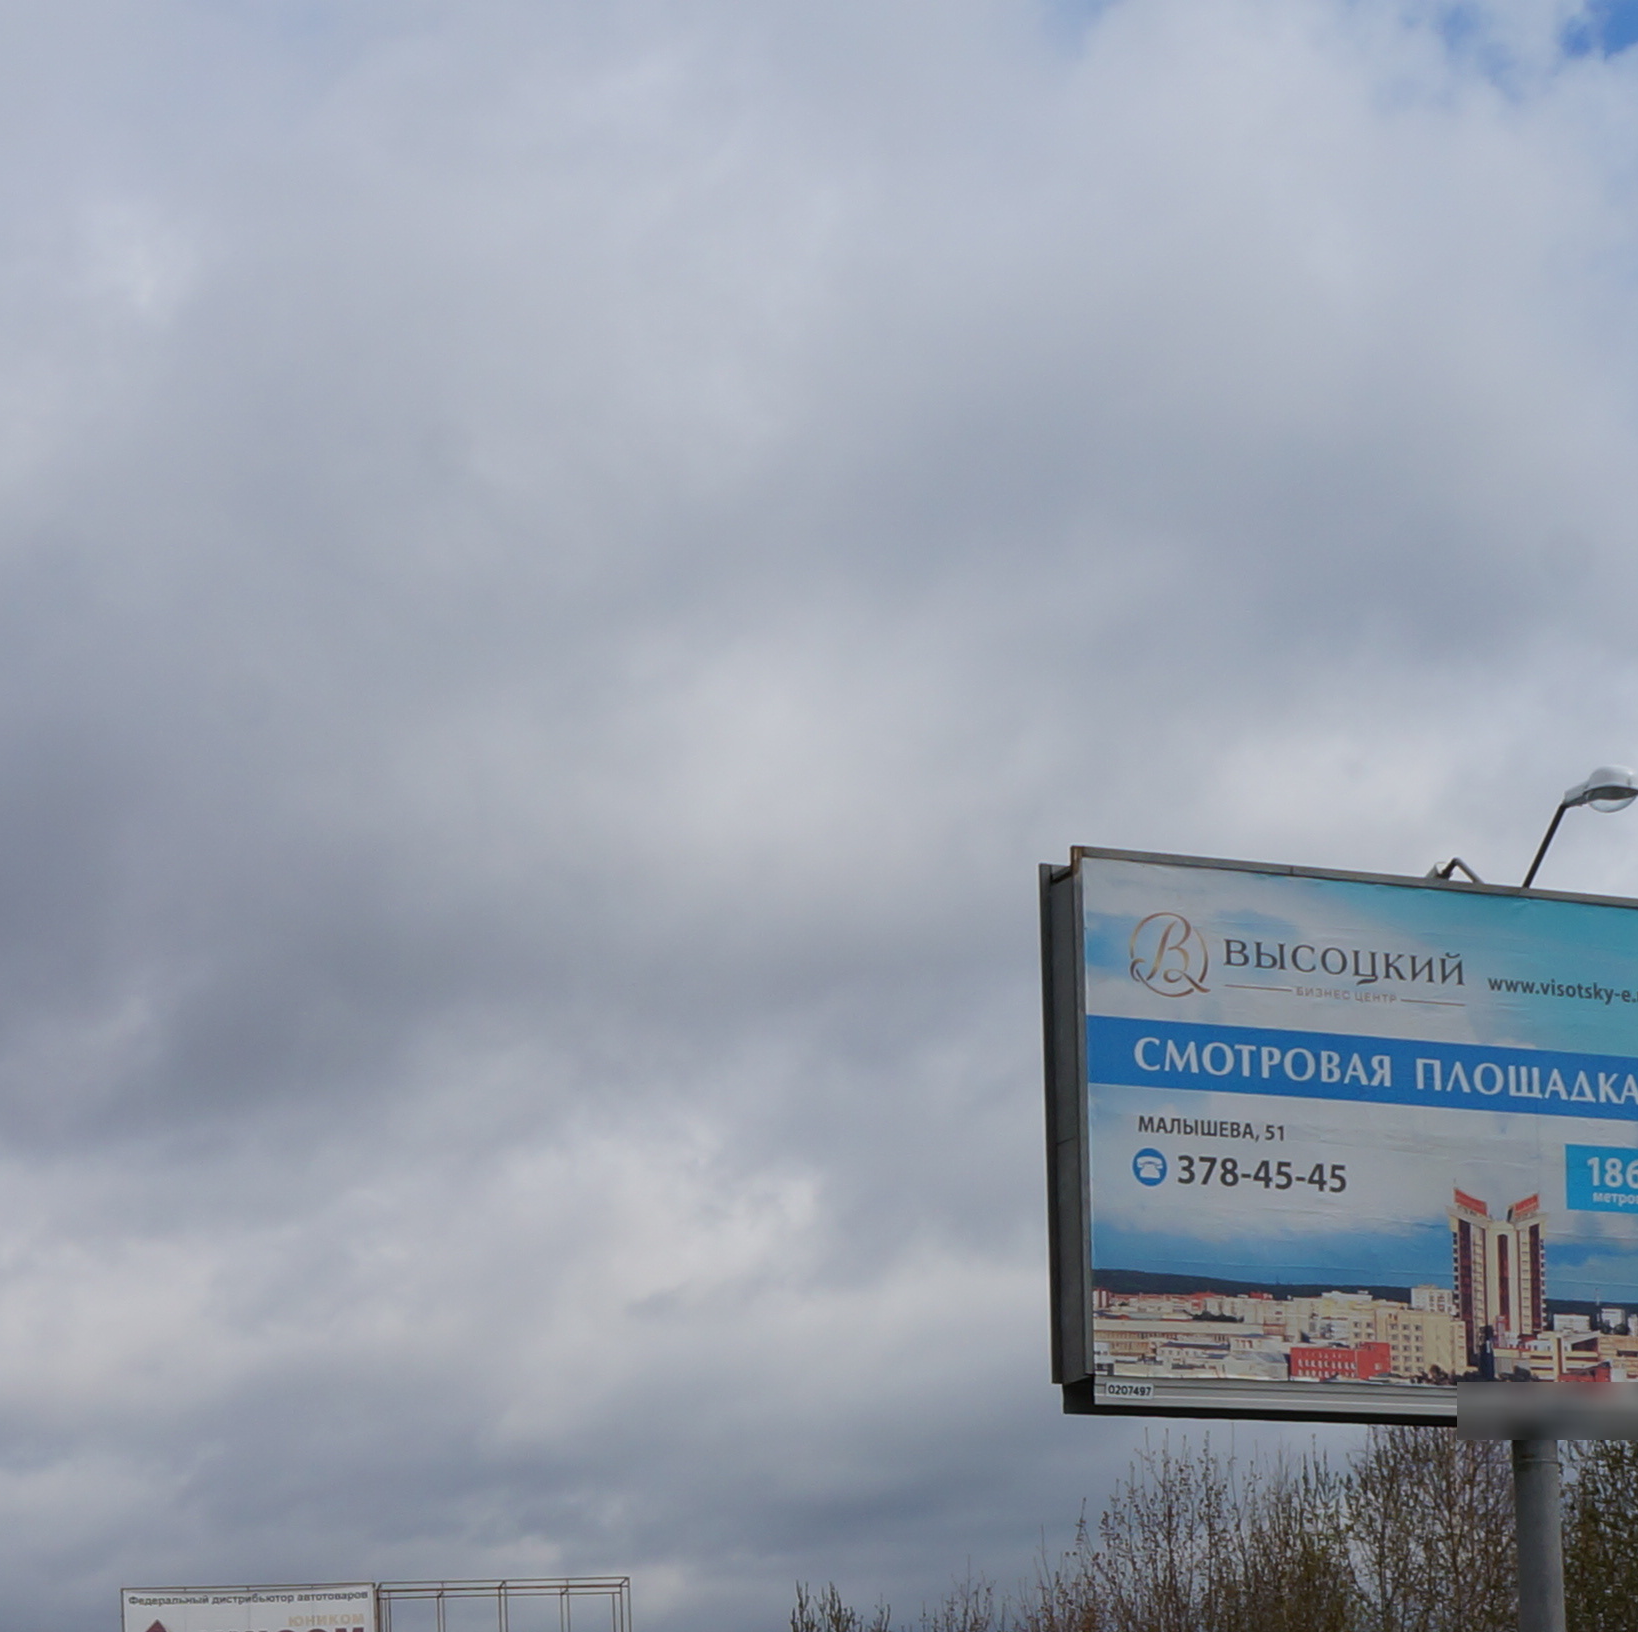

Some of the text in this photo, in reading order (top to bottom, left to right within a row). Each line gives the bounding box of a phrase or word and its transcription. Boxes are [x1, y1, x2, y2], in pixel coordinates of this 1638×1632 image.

[1223, 938, 1466, 986] ВЫСОЦКИЙ
[1296, 986, 1397, 1003] БИЗНЕС ЦЕНТР
[1133, 1036, 1392, 1087] СМОТРОВАЯ
[1137, 1115, 1286, 1143] МАЛЫШЕВА, 51
[1176, 1153, 1347, 1194] 378-45-45
[1107, 1384, 1152, 1396] 0207497
[128, 1591, 369, 1607] Федеральный дистрибьютор автотоваров
[288, 1613, 365, 1627] ЮНИКОМ
